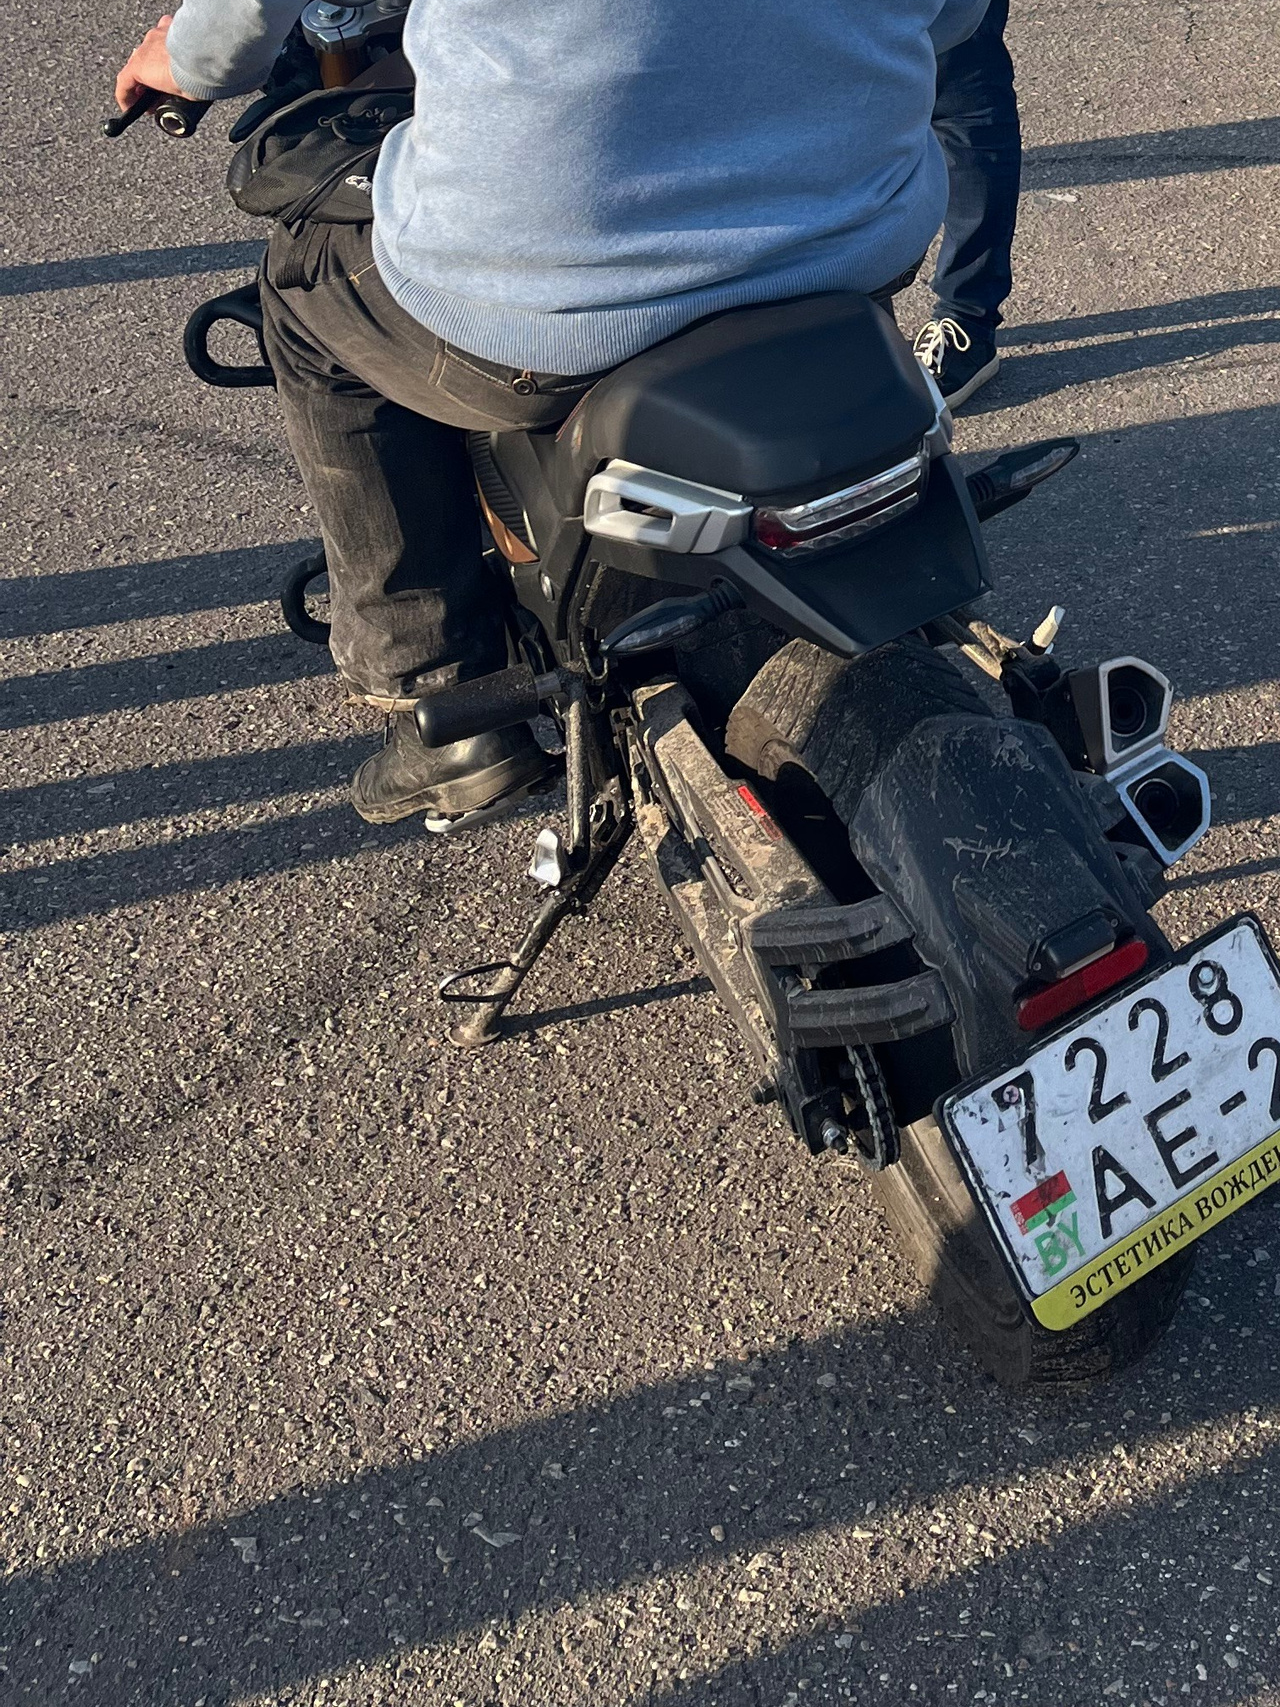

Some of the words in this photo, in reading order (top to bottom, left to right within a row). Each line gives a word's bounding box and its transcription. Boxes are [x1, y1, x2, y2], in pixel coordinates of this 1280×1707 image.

[991, 959, 1244, 1166] 7228
[1034, 1211, 1087, 1278] BY
[1070, 1215, 1195, 1309] ЭСТЕТИКА
